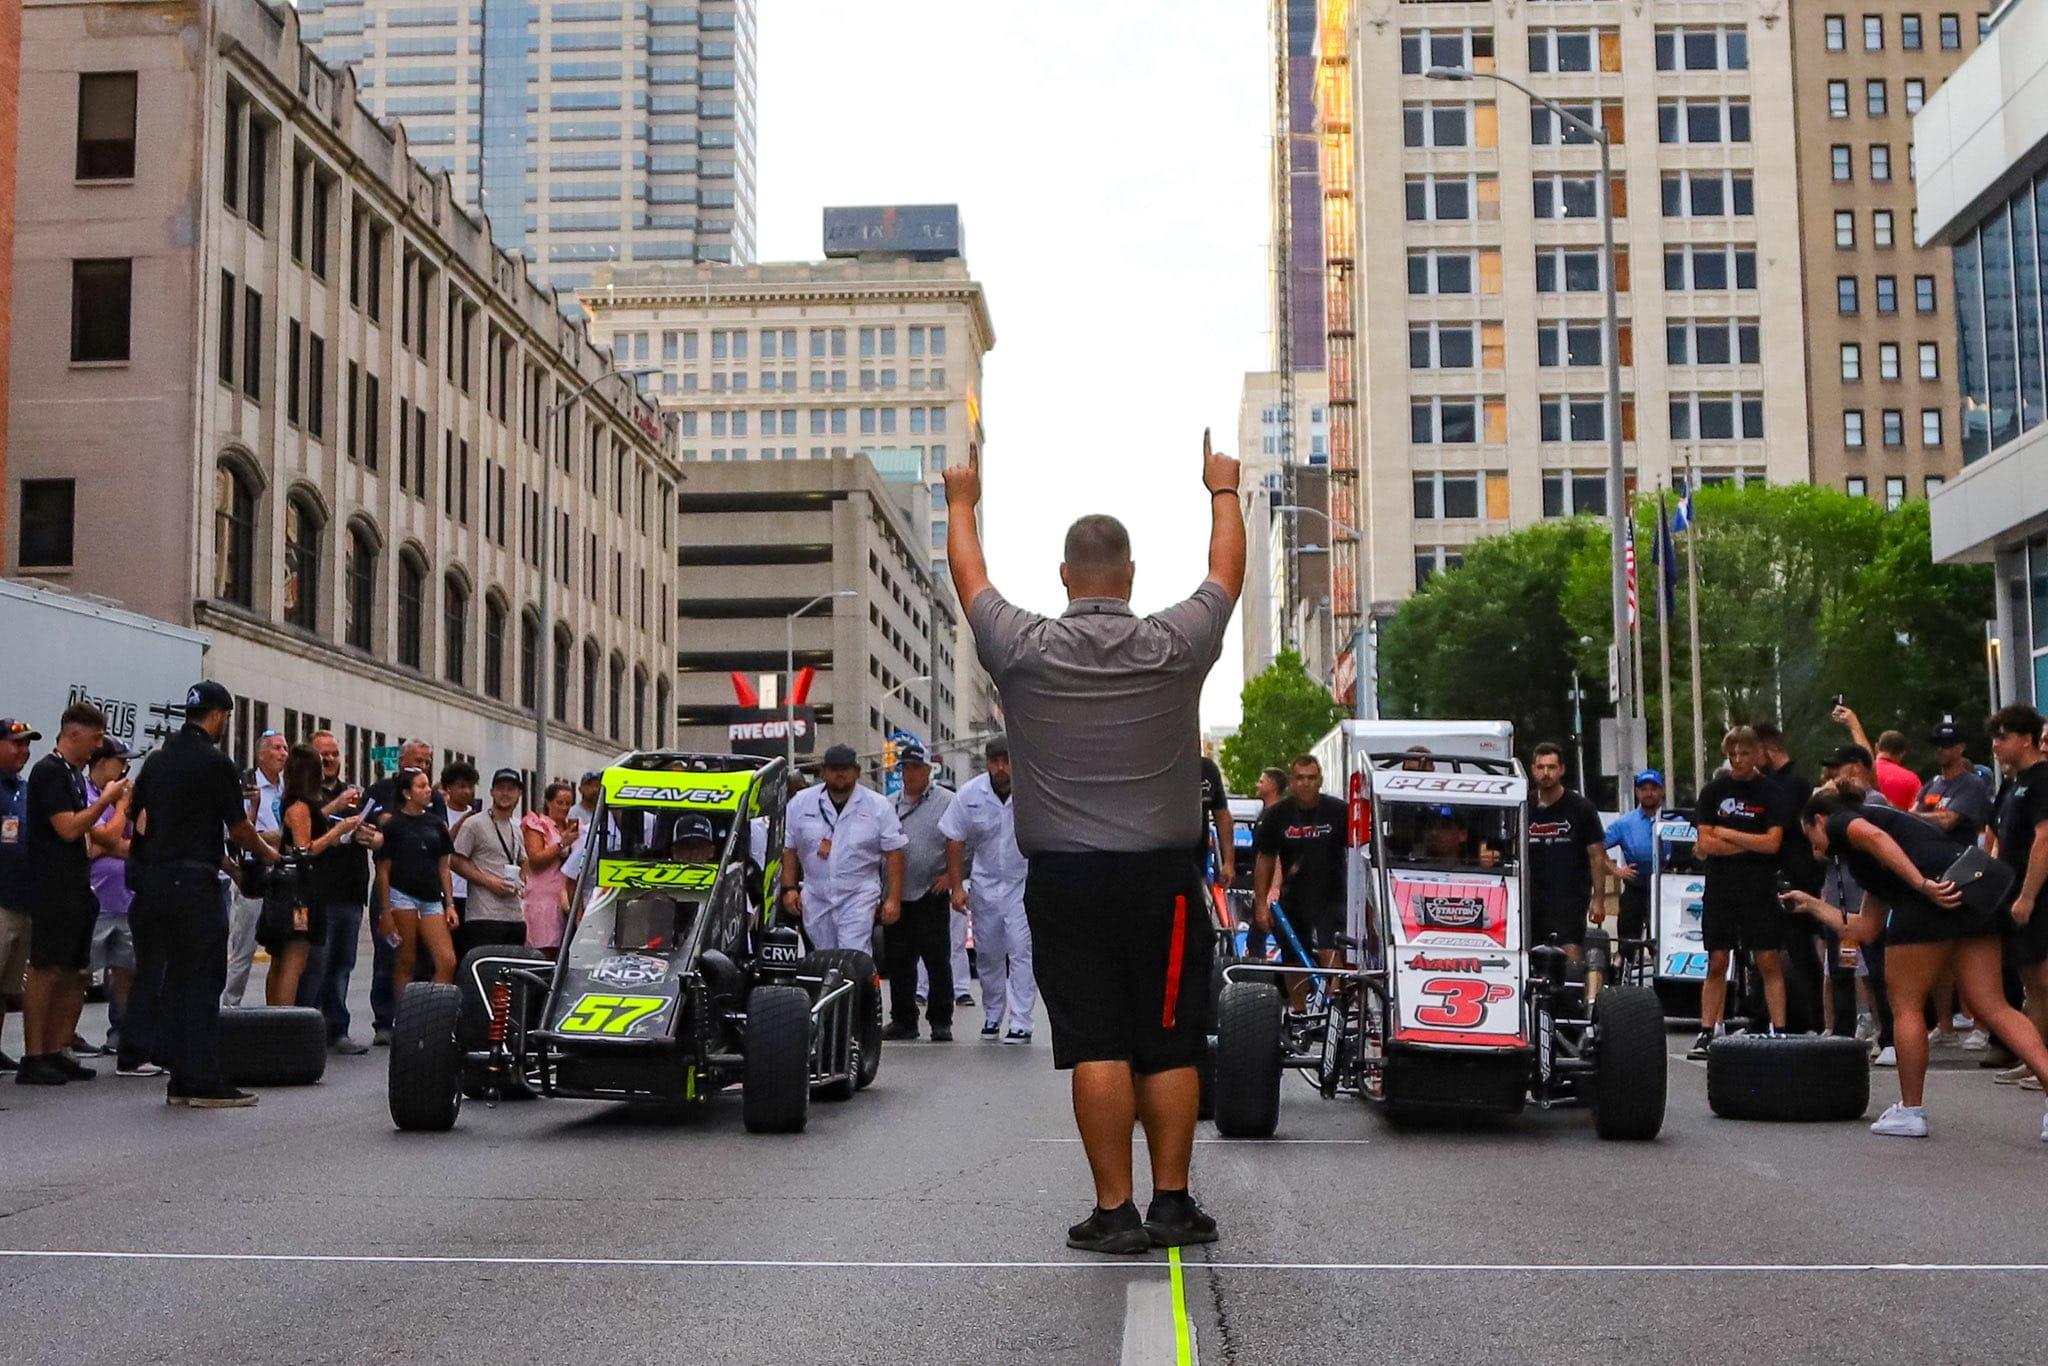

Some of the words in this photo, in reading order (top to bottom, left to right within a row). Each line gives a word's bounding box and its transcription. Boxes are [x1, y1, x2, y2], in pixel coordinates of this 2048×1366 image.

[57, 684, 138, 739] Acus
[728, 723, 763, 739] FIVE
[763, 718, 806, 738] GUYS
[1385, 776, 1515, 794] PECK
[615, 786, 733, 803] SEAVEY
[762, 946, 798, 961] CRW
[592, 969, 664, 980] INDY
[560, 995, 664, 1033] 57
